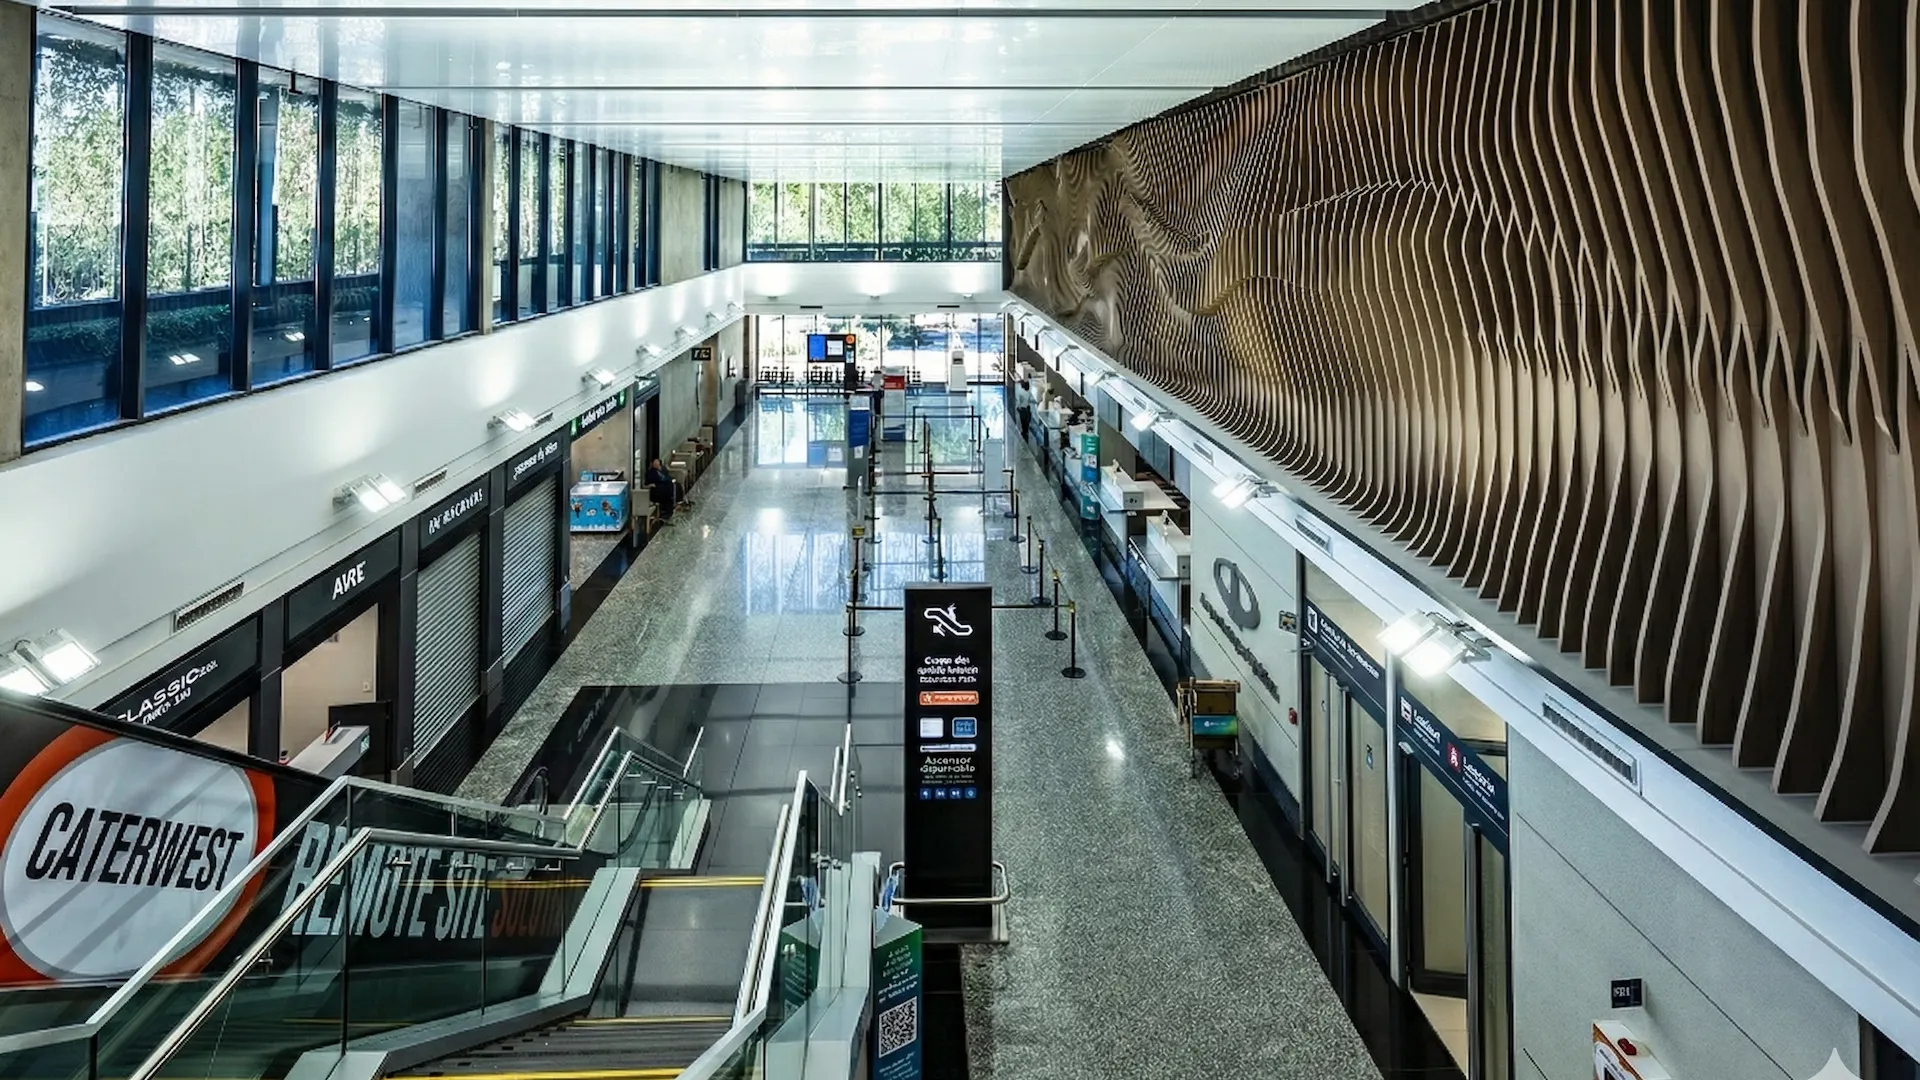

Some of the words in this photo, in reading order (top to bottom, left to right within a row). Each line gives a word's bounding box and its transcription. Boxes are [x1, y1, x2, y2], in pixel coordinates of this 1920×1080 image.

[25, 802, 245, 892] CATERWEST
[281, 820, 442, 939] REMOTE
[435, 850, 498, 941] SITE
